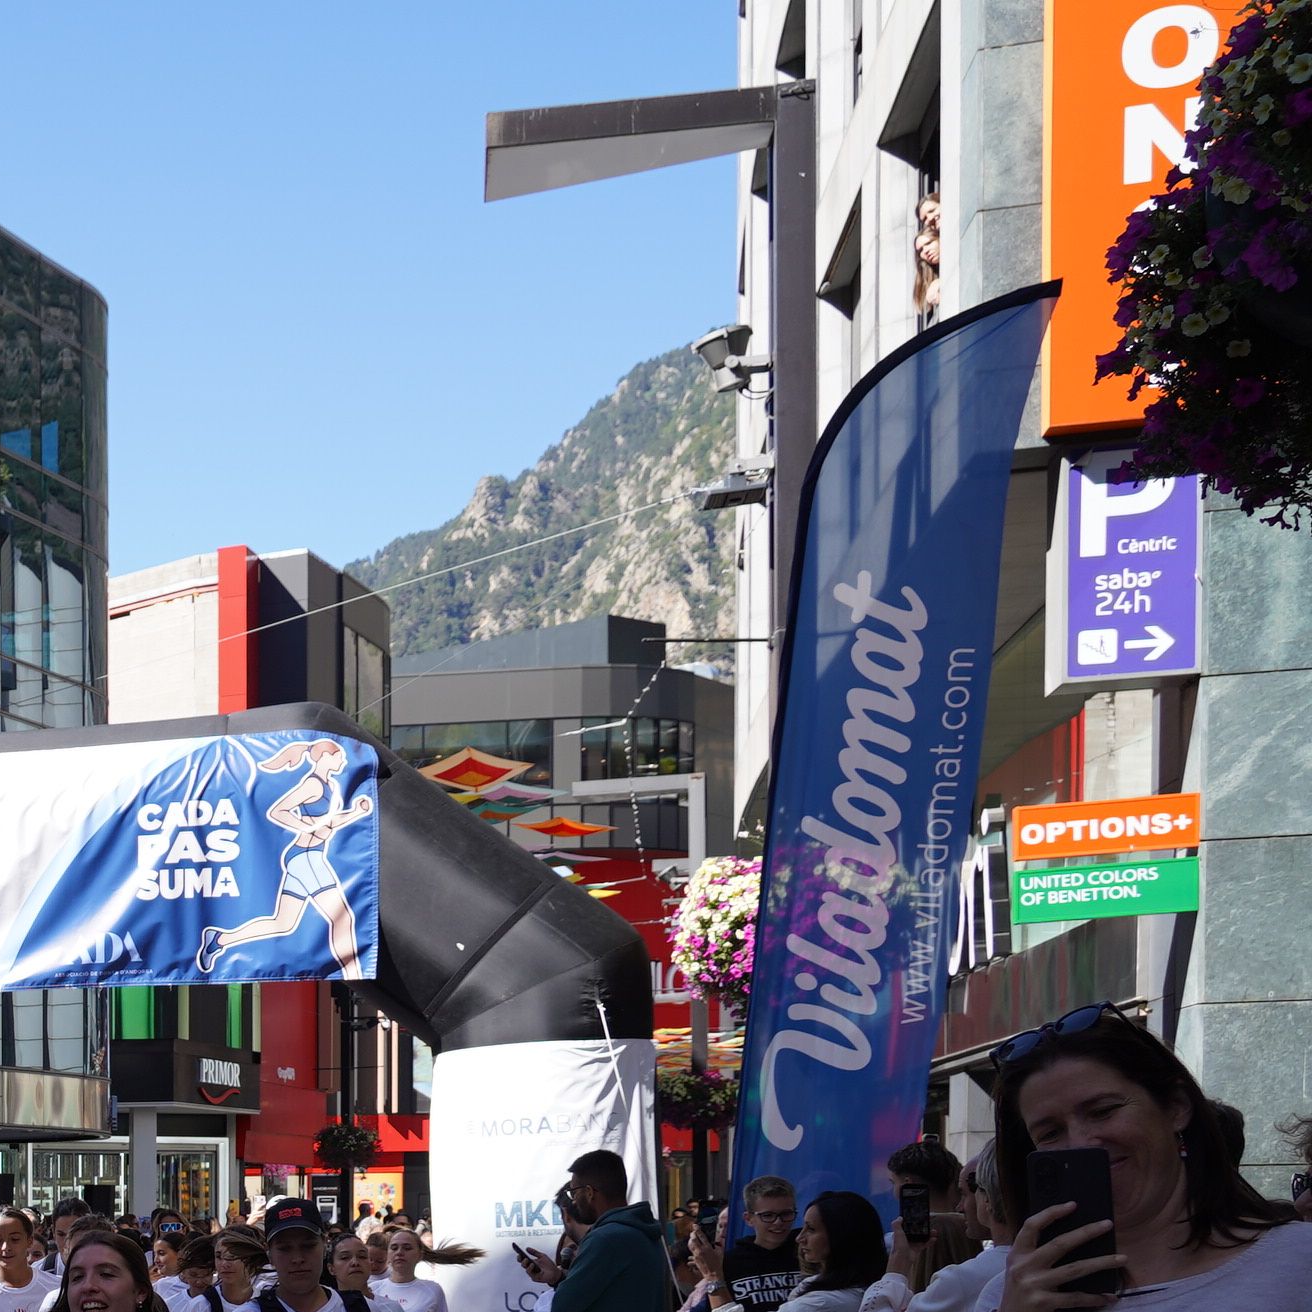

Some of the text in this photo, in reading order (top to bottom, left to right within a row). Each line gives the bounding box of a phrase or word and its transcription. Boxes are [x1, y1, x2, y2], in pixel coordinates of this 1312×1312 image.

[1078, 443, 1174, 558] P
[1117, 535, 1177, 555] Cèntric
[1094, 568, 1162, 592] saba
[1094, 593, 1151, 616] 24h
[137, 798, 240, 830] CADA
[1019, 812, 1192, 847] OPTIONS+
[137, 829, 241, 864] PAS
[900, 646, 976, 1024] www.viladomat.com
[761, 570, 928, 1151] Viladomat
[136, 867, 240, 900] SUMA
[1020, 866, 1159, 890] UNITED COLORS
[1020, 884, 1141, 906] OF BENETTON.
[72, 931, 143, 964] ADA
[201, 1058, 241, 1087] PRIMOR
